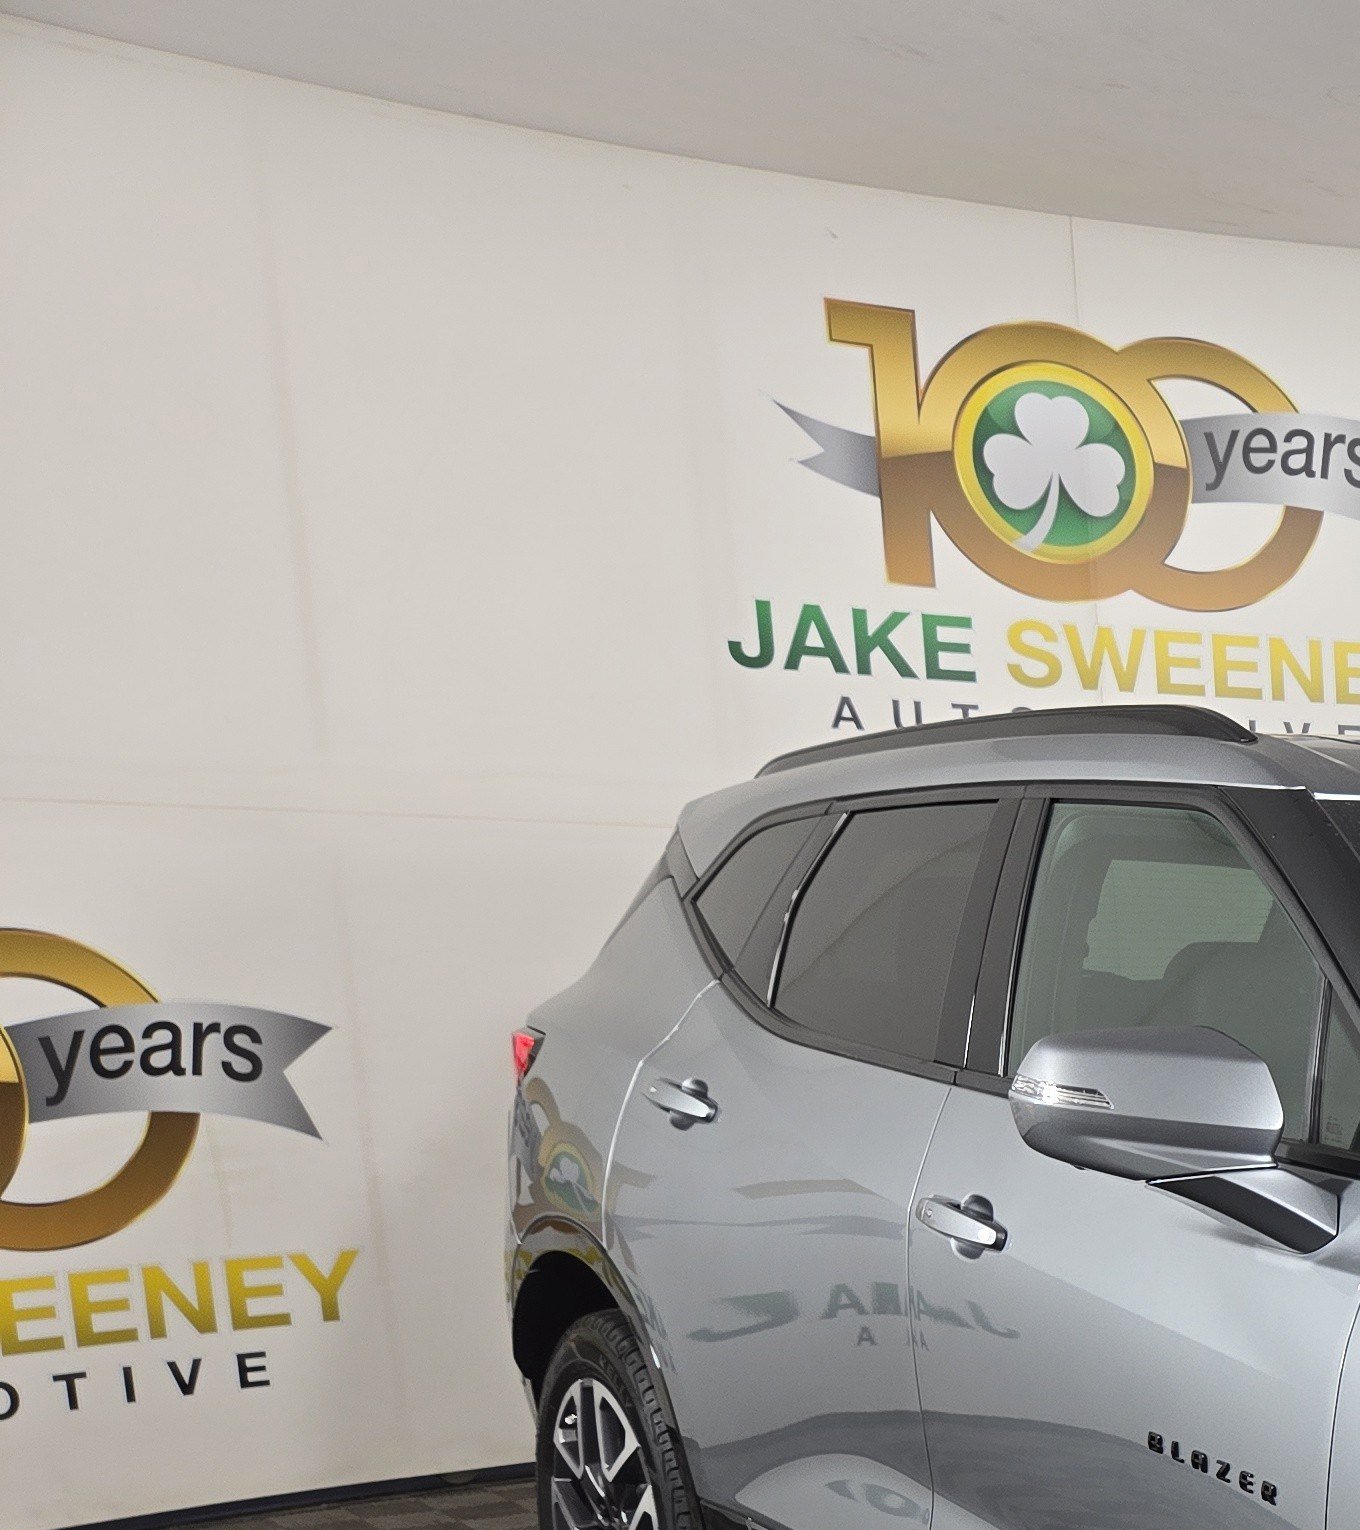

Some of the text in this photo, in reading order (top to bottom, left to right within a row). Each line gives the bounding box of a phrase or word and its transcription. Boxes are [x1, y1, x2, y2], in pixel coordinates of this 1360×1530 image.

[728, 599, 976, 684] JAKE
[38, 1019, 263, 1107] years
[1148, 1431, 1277, 1506] BLAZER
